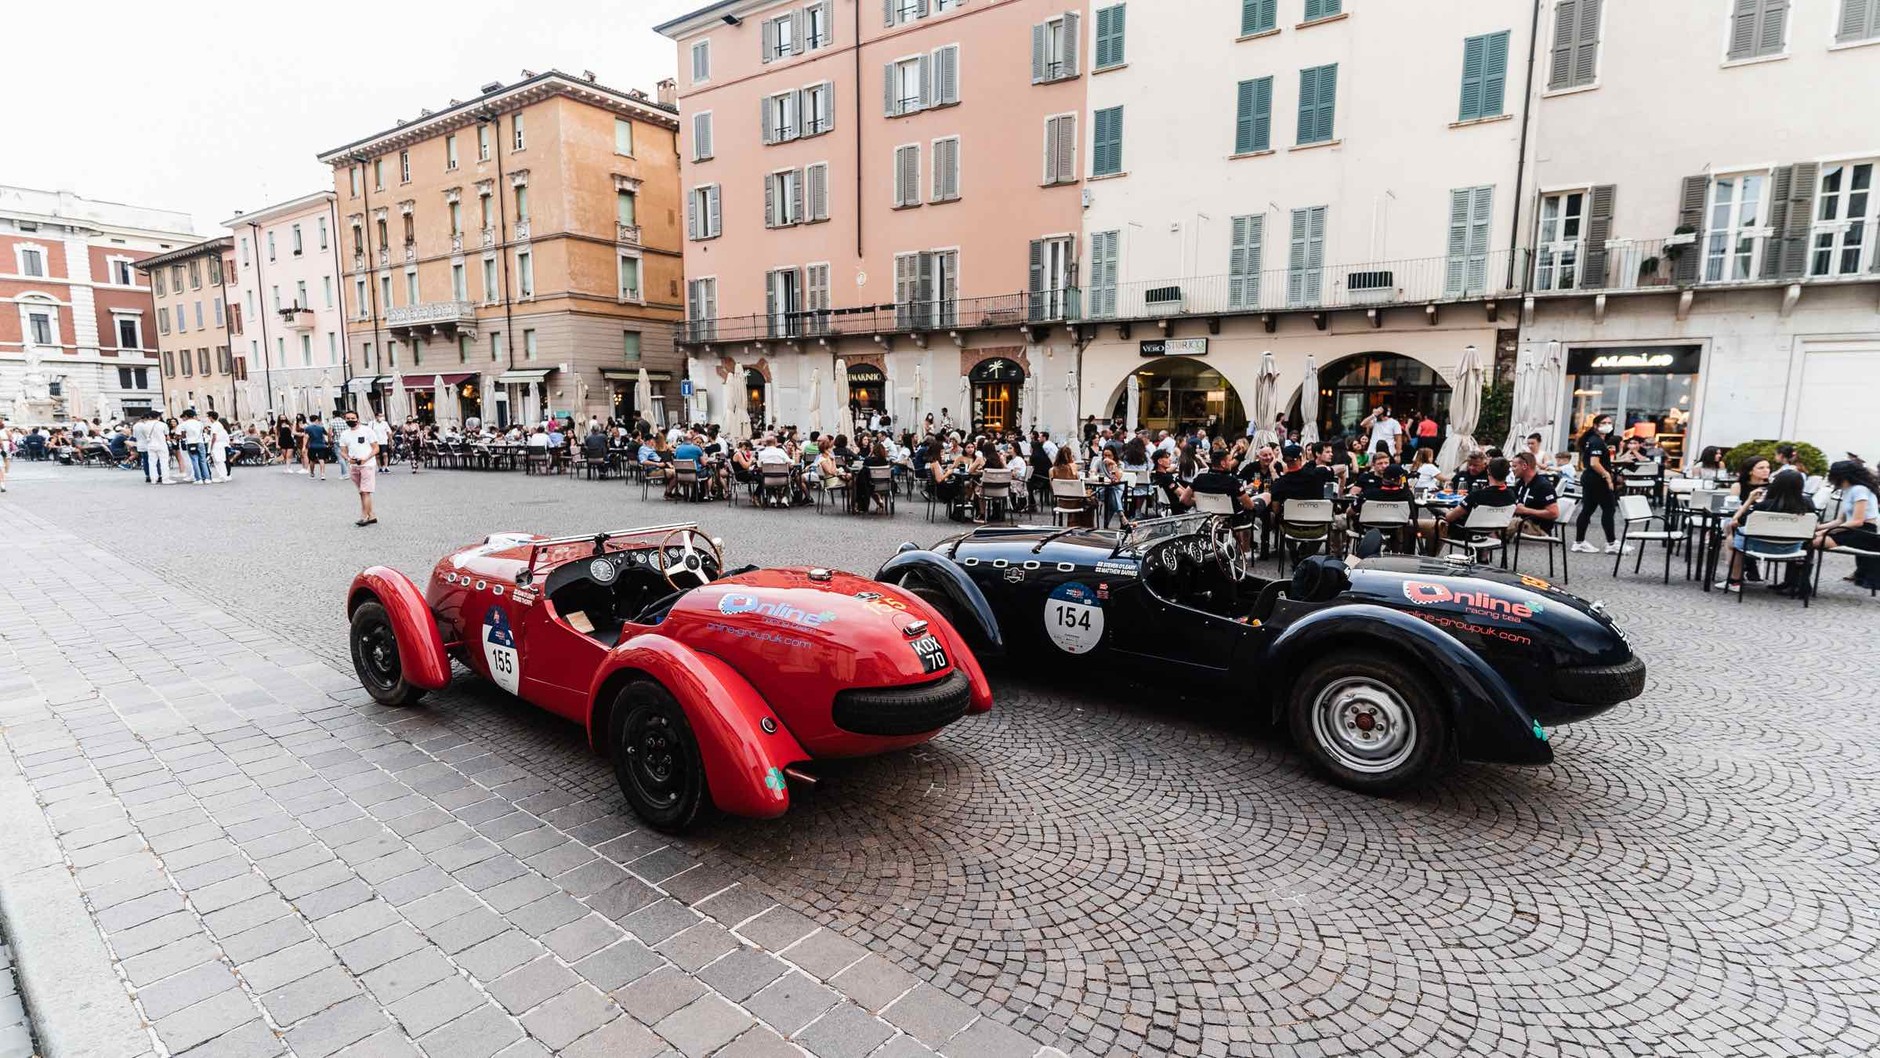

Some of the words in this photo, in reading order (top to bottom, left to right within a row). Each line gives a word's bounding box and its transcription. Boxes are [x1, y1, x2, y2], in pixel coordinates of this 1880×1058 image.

[718, 593, 822, 626] Online
[863, 597, 907, 615] 155
[1402, 580, 1533, 618] Online
[1056, 605, 1091, 631] 154
[1465, 606, 1500, 620] racing
[911, 636, 942, 656] KOX
[492, 648, 513, 675] 155
[925, 651, 946, 670] 70
